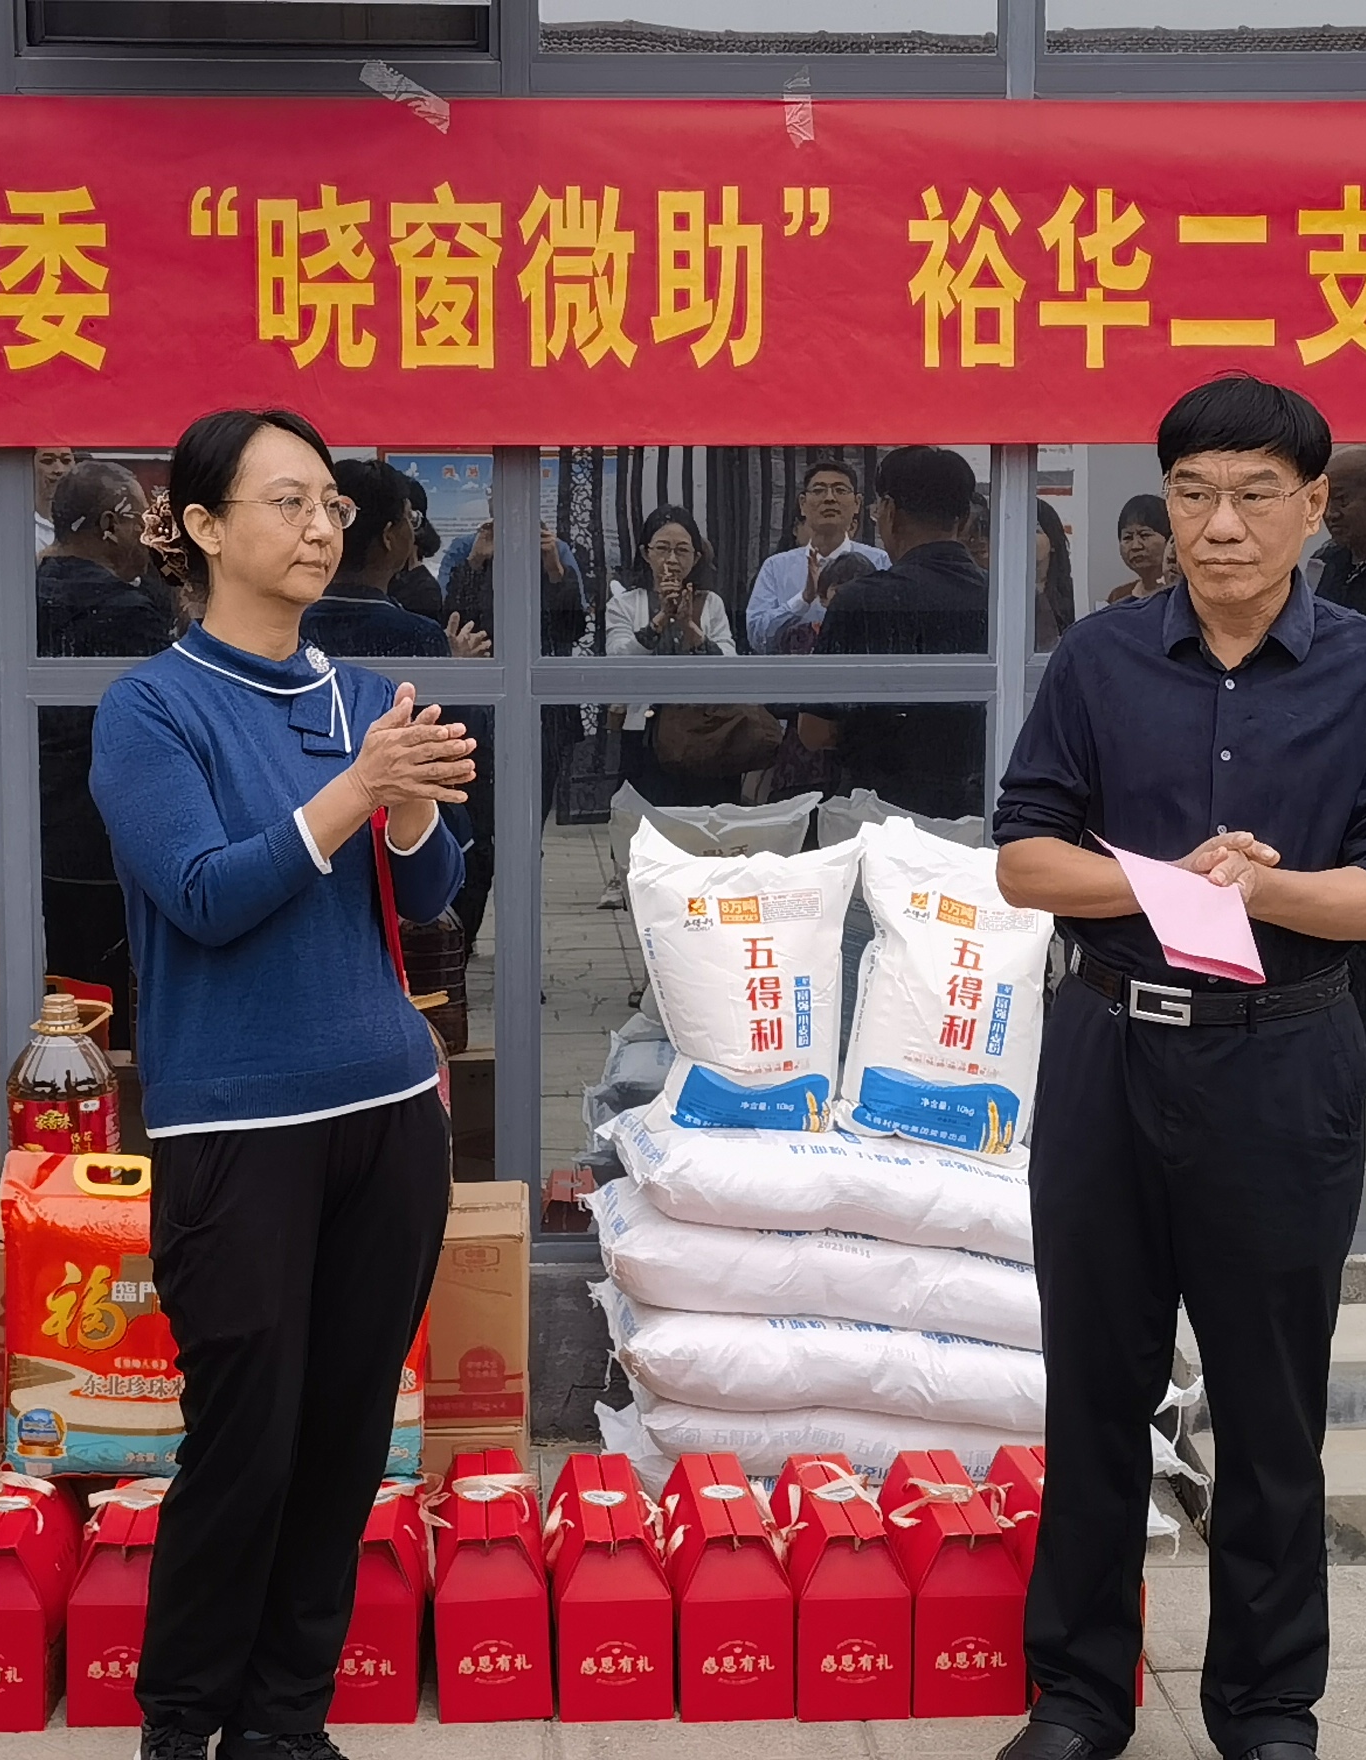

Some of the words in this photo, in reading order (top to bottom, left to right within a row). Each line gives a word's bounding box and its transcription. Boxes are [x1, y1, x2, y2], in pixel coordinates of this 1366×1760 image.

[743, 936, 784, 1052] 五得利
[939, 937, 985, 1051] 五得利
[335, 1658, 397, 1677] 恩有礼
[459, 1654, 533, 1676] 感恩有礼
[580, 1654, 655, 1676] 感恩有礼
[702, 1654, 776, 1676] 感恩有礼
[820, 1653, 894, 1673] 感恩有礼
[935, 1650, 1007, 1671] 感恩有礼
